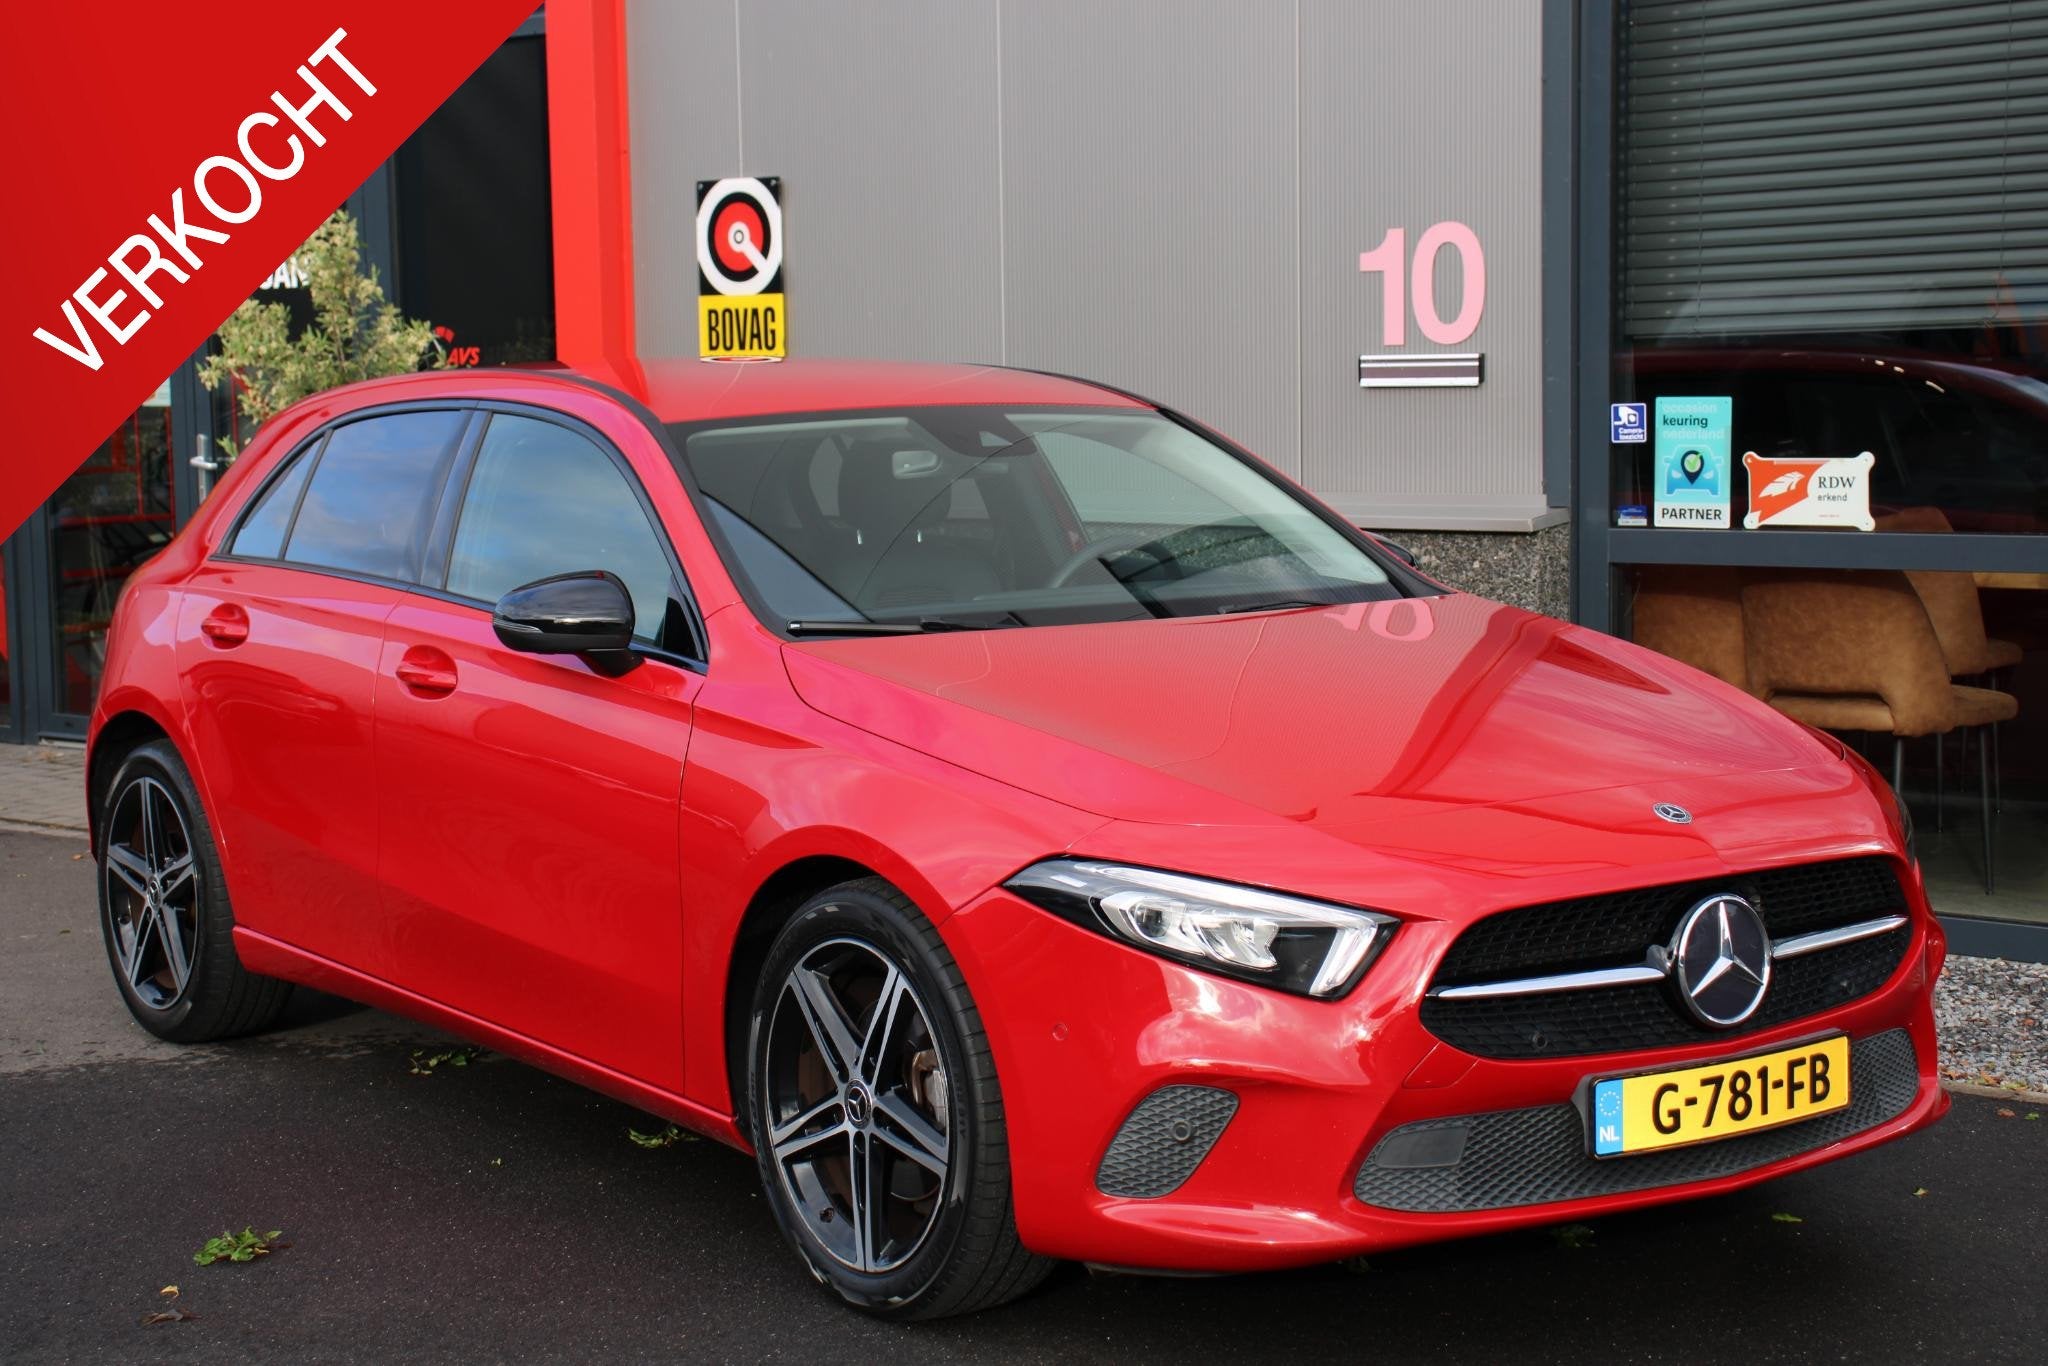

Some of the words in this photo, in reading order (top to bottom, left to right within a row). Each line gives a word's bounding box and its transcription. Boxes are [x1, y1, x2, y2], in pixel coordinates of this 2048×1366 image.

[1359, 221, 1486, 346] 10
[707, 307, 776, 351] BOVAG
[447, 347, 480, 365] AVS
[1663, 414, 1708, 428] keuring
[1818, 476, 1856, 488] RDW
[1817, 493, 1848, 501] erkend
[1661, 508, 1723, 520] PARTNER
[1652, 1052, 1831, 1135] G-781-FB
[1599, 1125, 1620, 1144] NL
